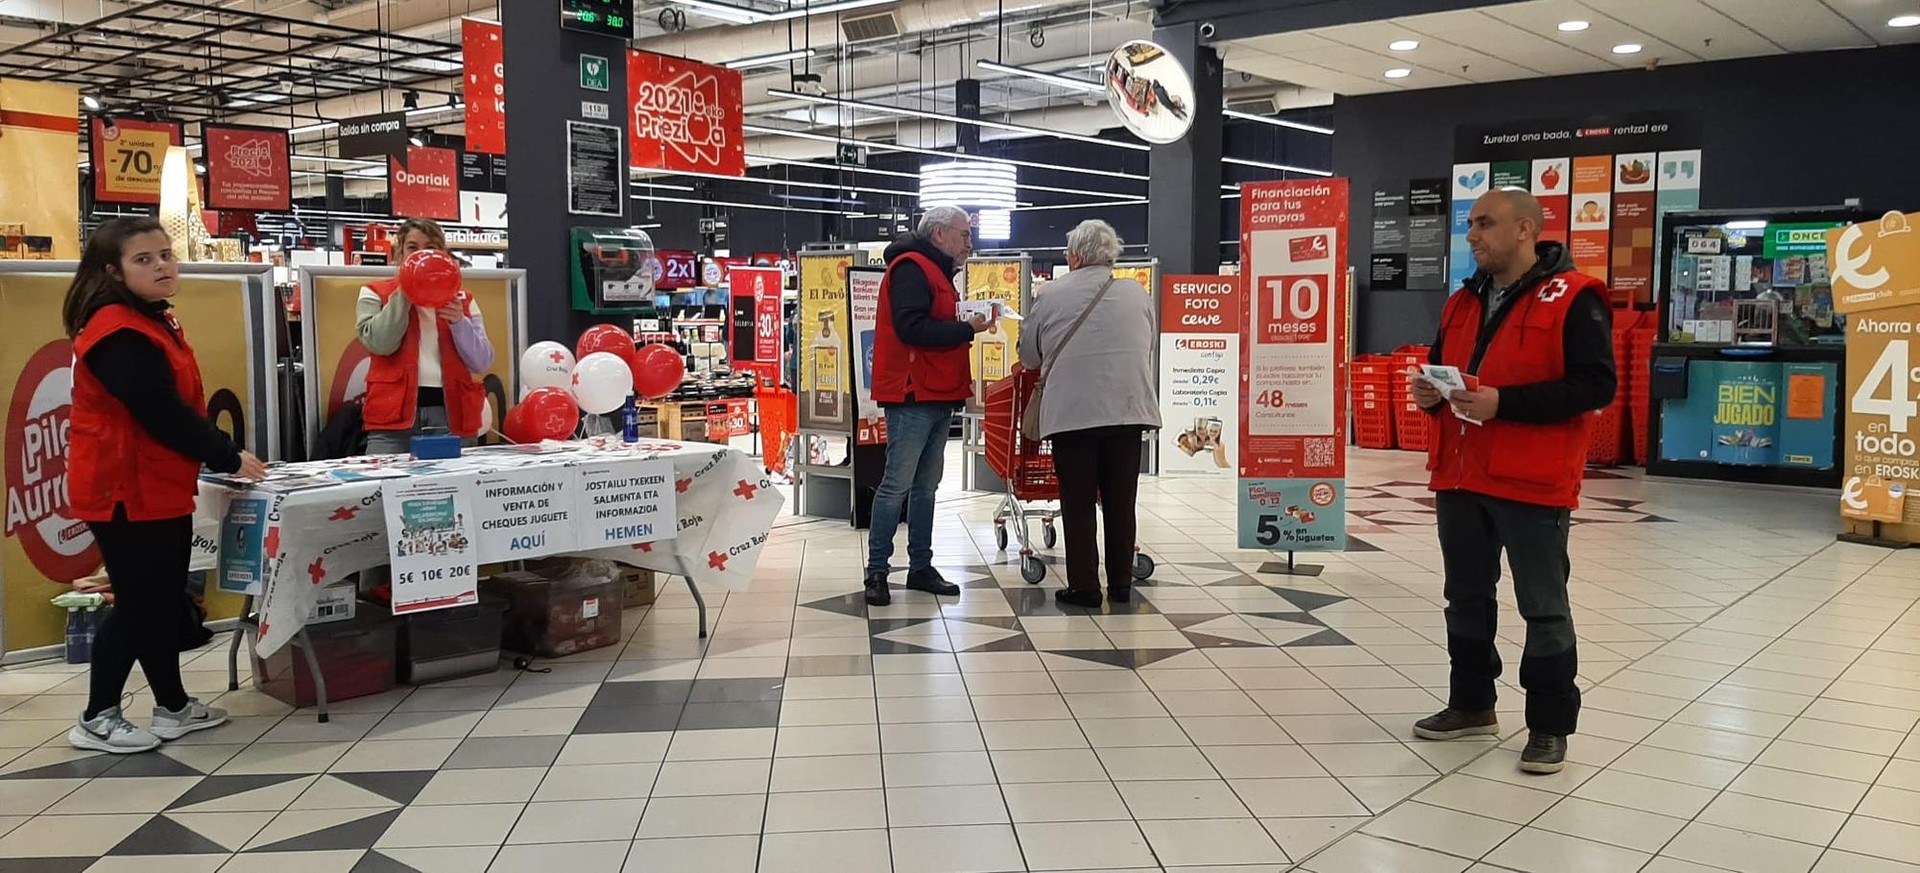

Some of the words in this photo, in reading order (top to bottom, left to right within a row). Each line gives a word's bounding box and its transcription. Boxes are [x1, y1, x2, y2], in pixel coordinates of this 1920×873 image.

[587, 78, 602, 87] DEA
[640, 82, 691, 115] 2021
[705, 104, 724, 119] eko
[340, 124, 360, 137] Salida
[360, 122, 371, 134] sin
[371, 120, 400, 134] compra
[1483, 132, 1519, 145] Zuretzat
[1522, 134, 1541, 142] ona
[1543, 131, 1572, 141] bada,
[1614, 124, 1649, 135] rentzat
[395, 170, 450, 187] Opariak
[1251, 186, 1331, 200] Financiación
[1251, 201, 1281, 213] para
[1283, 199, 1302, 210] tus
[1251, 212, 1306, 224] compras
[1691, 239, 1718, 248] 064
[667, 259, 696, 278] 2x1
[809, 288, 819, 300] El
[1172, 283, 1232, 295] SERVICIO
[1184, 299, 1220, 310] FOTO
[1266, 278, 1320, 321] 10
[1181, 314, 1222, 325] cewe
[1856, 318, 1912, 333] Ahorra
[1268, 322, 1317, 334] meses
[1190, 340, 1225, 349] EROSKI
[1256, 389, 1284, 408] 48
[1718, 385, 1776, 404] BIEN
[1713, 403, 1775, 426] JUGADO
[1867, 422, 1888, 434] en
[1855, 430, 1916, 456] todo
[694, 460, 715, 478] Cruz
[1854, 464, 1872, 475] en
[485, 481, 555, 499] INFORMACIÓN
[557, 481, 564, 491] Y
[585, 479, 628, 492] JOSTAILU
[629, 475, 666, 487] TXEKEEN
[502, 501, 536, 512] VENTA
[537, 498, 549, 508] DE
[593, 492, 642, 505] SALMENTA
[643, 490, 660, 500] ETA
[595, 504, 659, 520] INFORMAZIOA
[482, 516, 528, 530] CHEQUES
[530, 511, 569, 525] JUGUETE
[680, 514, 703, 530] Roja
[605, 523, 654, 541] HEMEN
[1256, 514, 1281, 546] 5
[510, 529, 546, 551] AQUÍ
[1295, 534, 1335, 543] juguetes
[729, 541, 752, 556] Cruz
[399, 571, 415, 585] 5€
[421, 568, 444, 582] 10€
[449, 564, 472, 578] 20€
